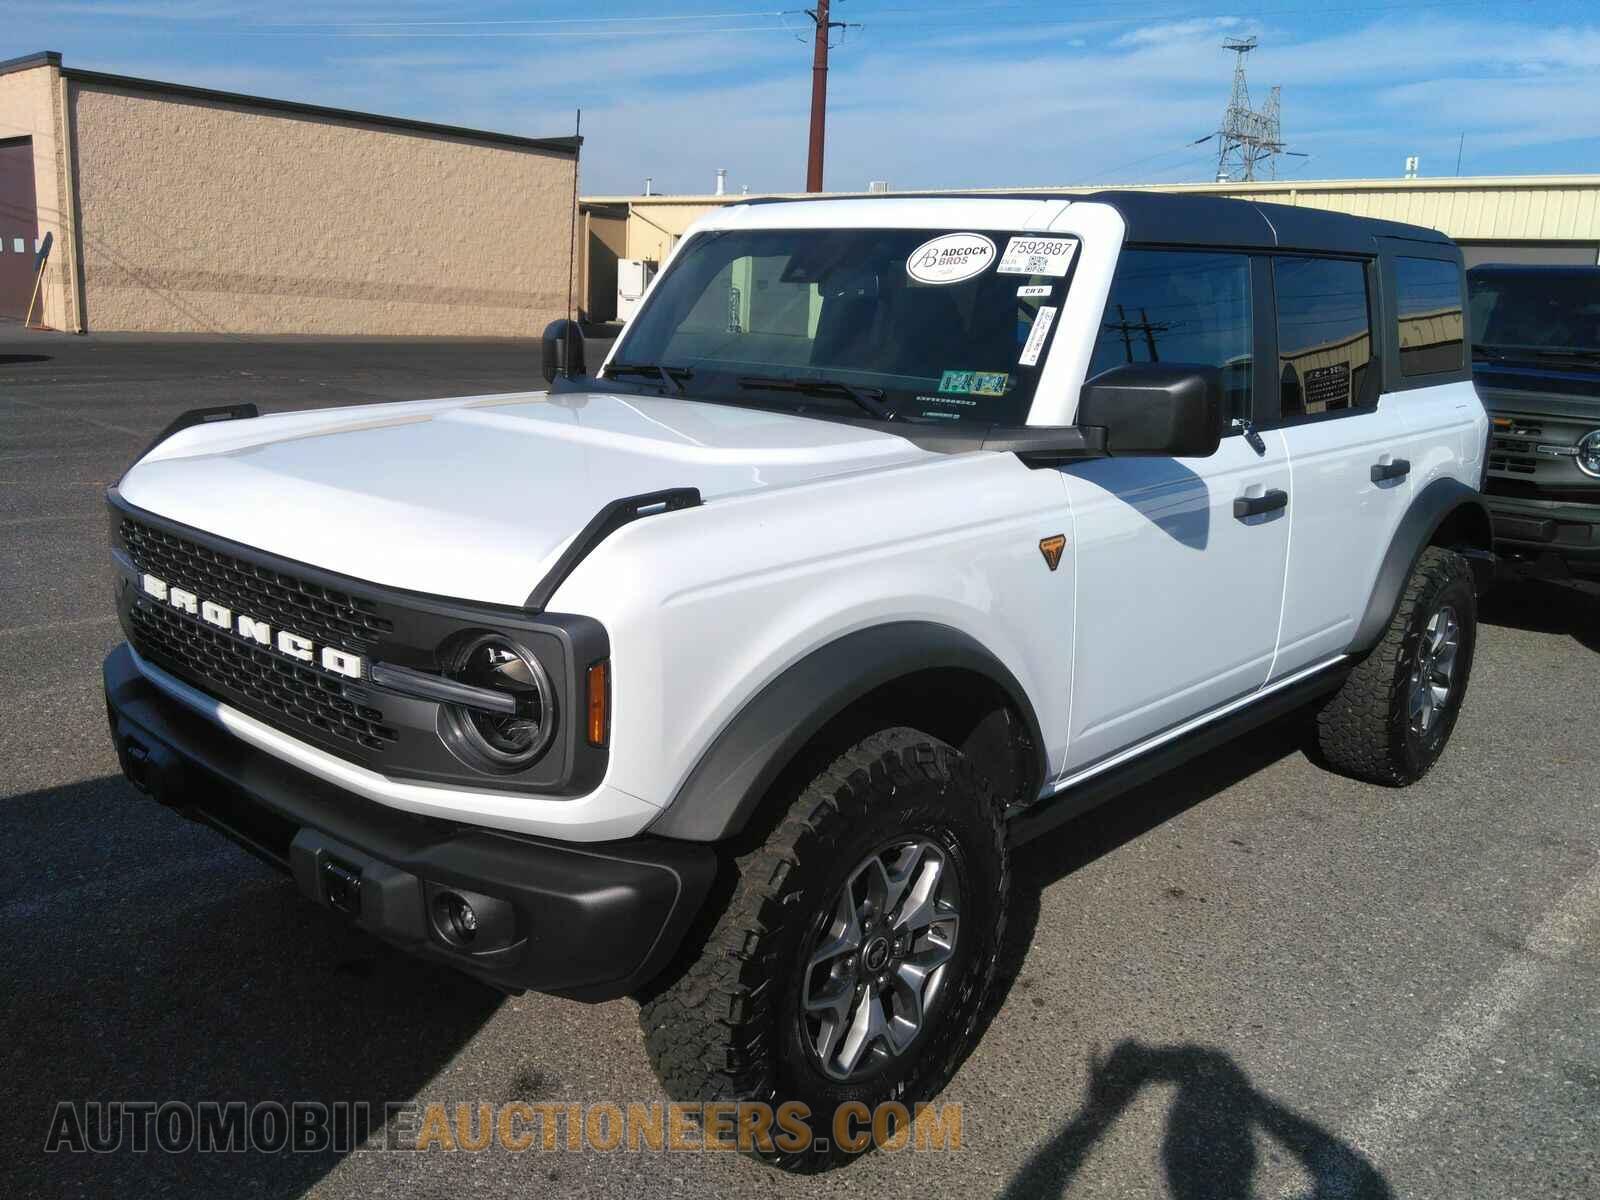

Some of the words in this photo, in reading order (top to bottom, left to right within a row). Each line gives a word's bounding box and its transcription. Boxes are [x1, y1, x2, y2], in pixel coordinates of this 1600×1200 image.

[941, 246, 989, 257] ADCOCK
[1010, 241, 1073, 257] 7592887
[937, 256, 969, 266] BROS
[143, 573, 361, 678] BRONCO
